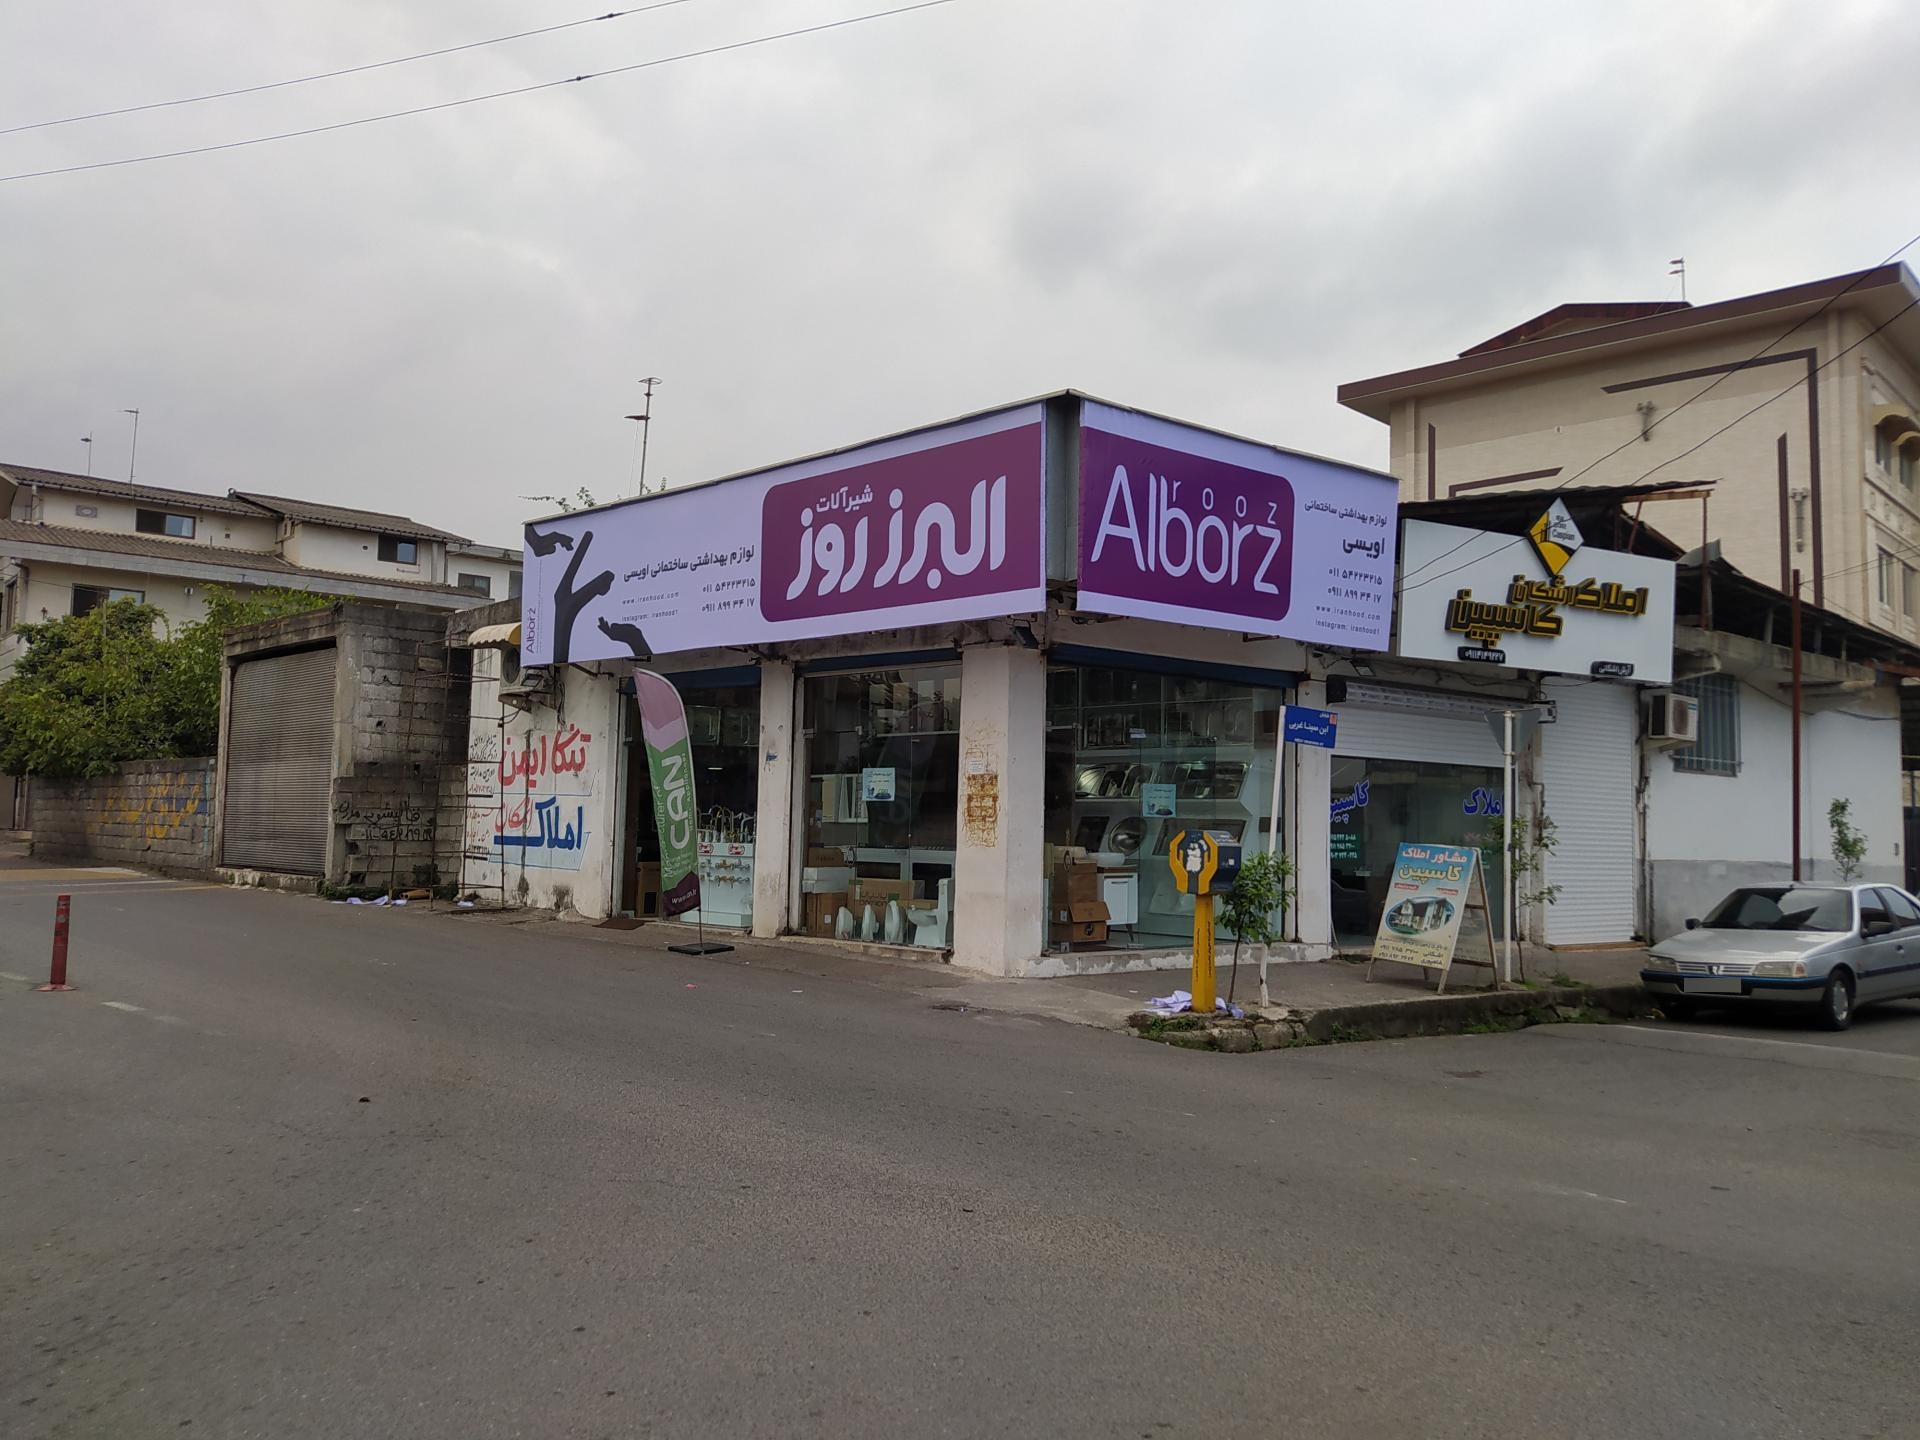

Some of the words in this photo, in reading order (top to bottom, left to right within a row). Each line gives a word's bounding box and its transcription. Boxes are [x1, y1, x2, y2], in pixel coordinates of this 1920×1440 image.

[1304, 500, 1338, 515] ساختمانی
[1338, 508, 1369, 524] بهداشتی
[1090, 464, 1282, 595] Alborz
[1369, 513, 1388, 528] لوازم
[873, 474, 1007, 590] البرز
[729, 544, 755, 565] لوازم
[786, 506, 869, 600] روز
[1342, 537, 1386, 560] اویسی
[623, 563, 650, 582] اویسی
[650, 557, 689, 578] ساختمانی
[690, 552, 728, 572] بهداشتی
[661, 755, 690, 850] CAN
[1399, 863, 1463, 885] کاسپین
